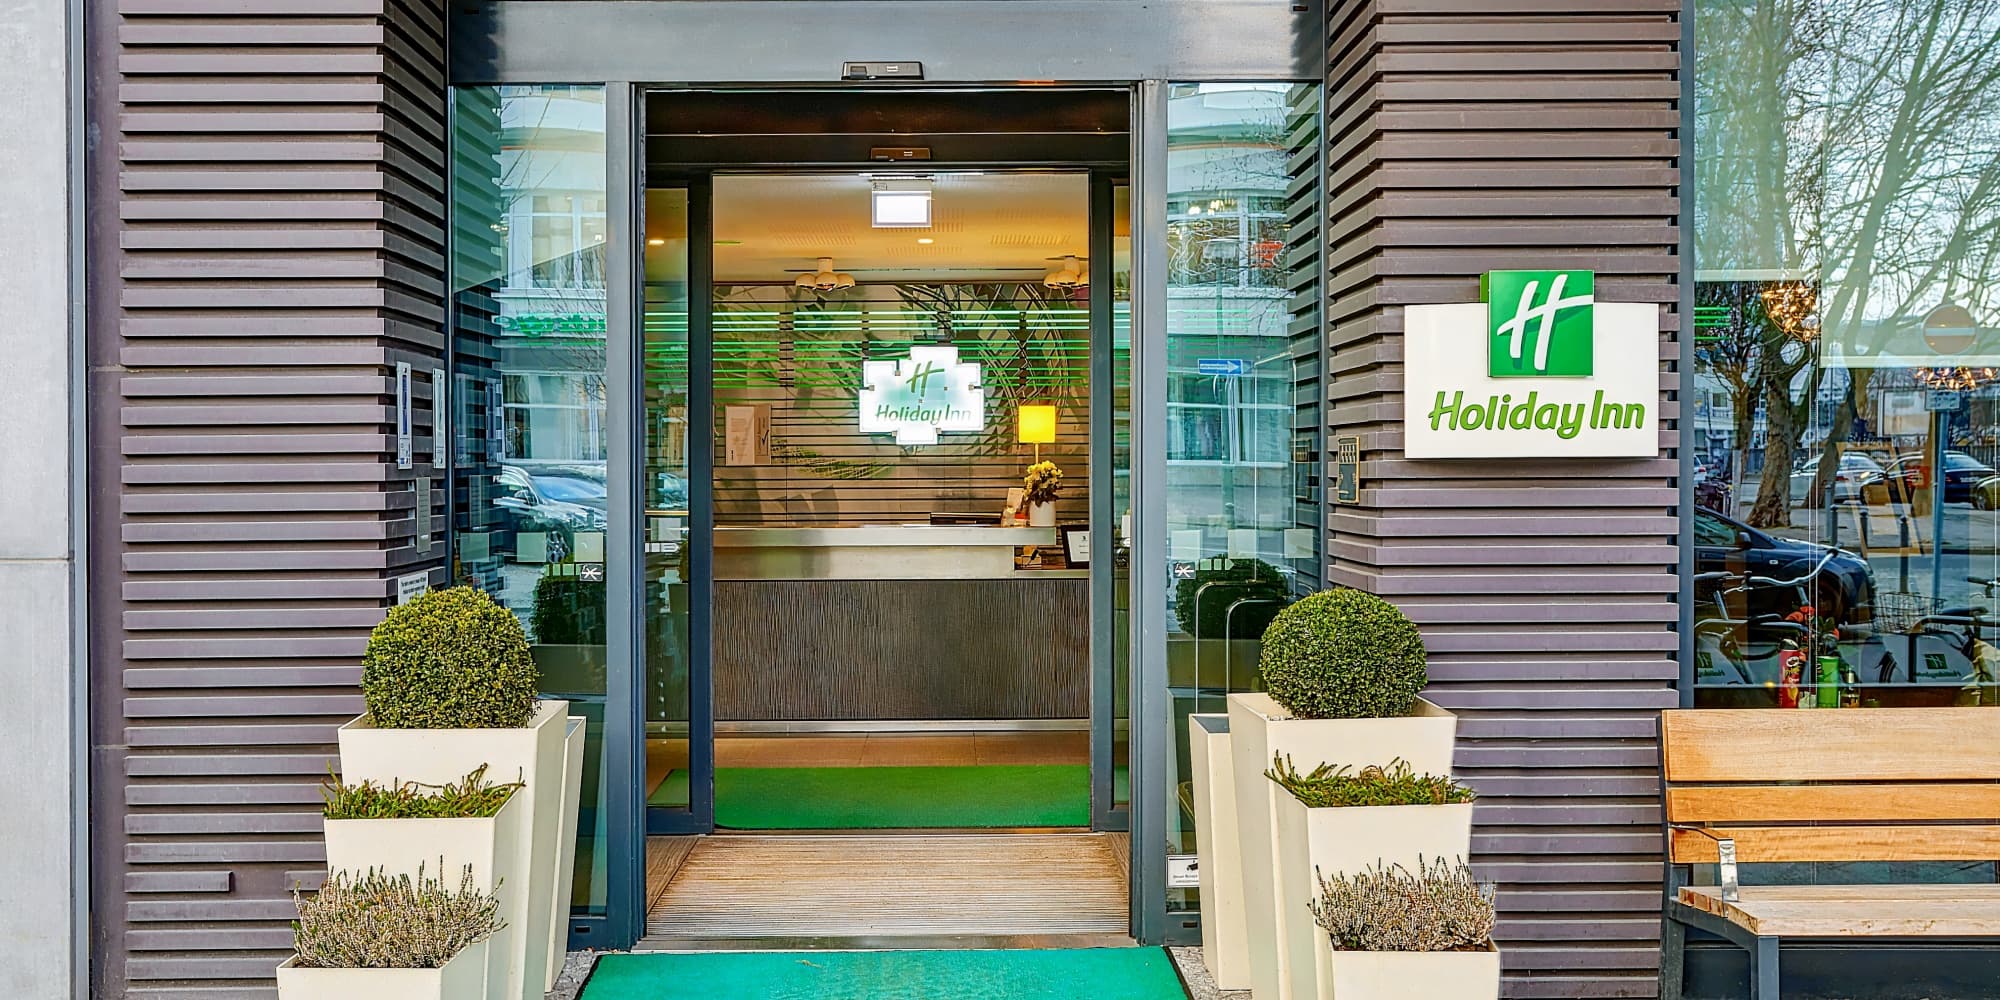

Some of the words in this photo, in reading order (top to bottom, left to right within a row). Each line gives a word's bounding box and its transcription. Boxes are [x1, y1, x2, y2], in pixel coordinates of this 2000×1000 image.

[1497, 274, 1593, 371] H
[906, 360, 945, 398] H
[875, 404, 942, 425] Holiday
[944, 403, 972, 422] Inn
[1428, 390, 1586, 439] Holiday
[1590, 390, 1645, 430] Inn
